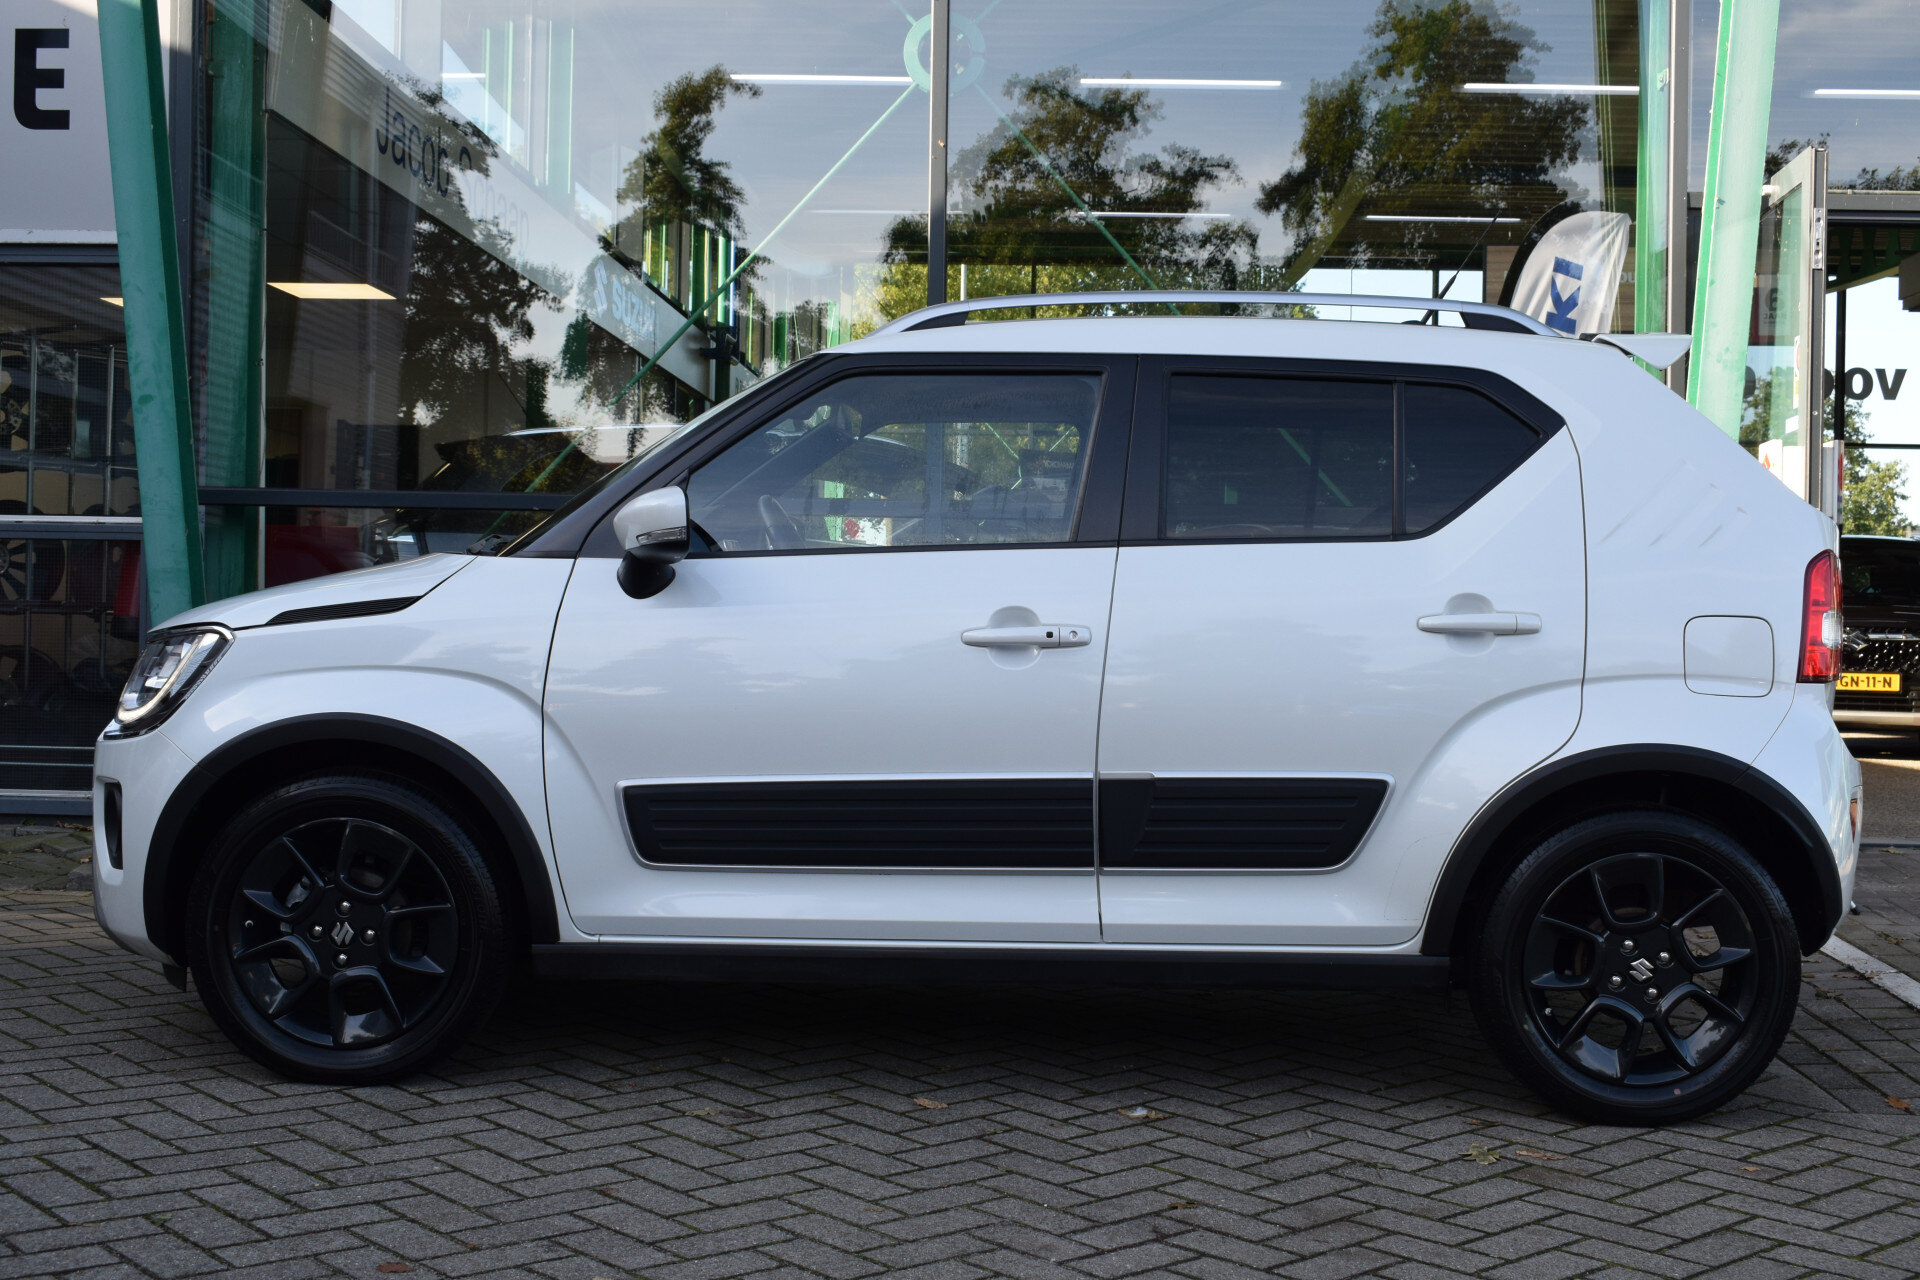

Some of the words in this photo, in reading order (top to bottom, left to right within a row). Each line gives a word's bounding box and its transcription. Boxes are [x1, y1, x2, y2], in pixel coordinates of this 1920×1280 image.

[13, 28, 70, 130] E
[376, 86, 450, 198] Jacob
[1836, 675, 1892, 688] GN-11-N
